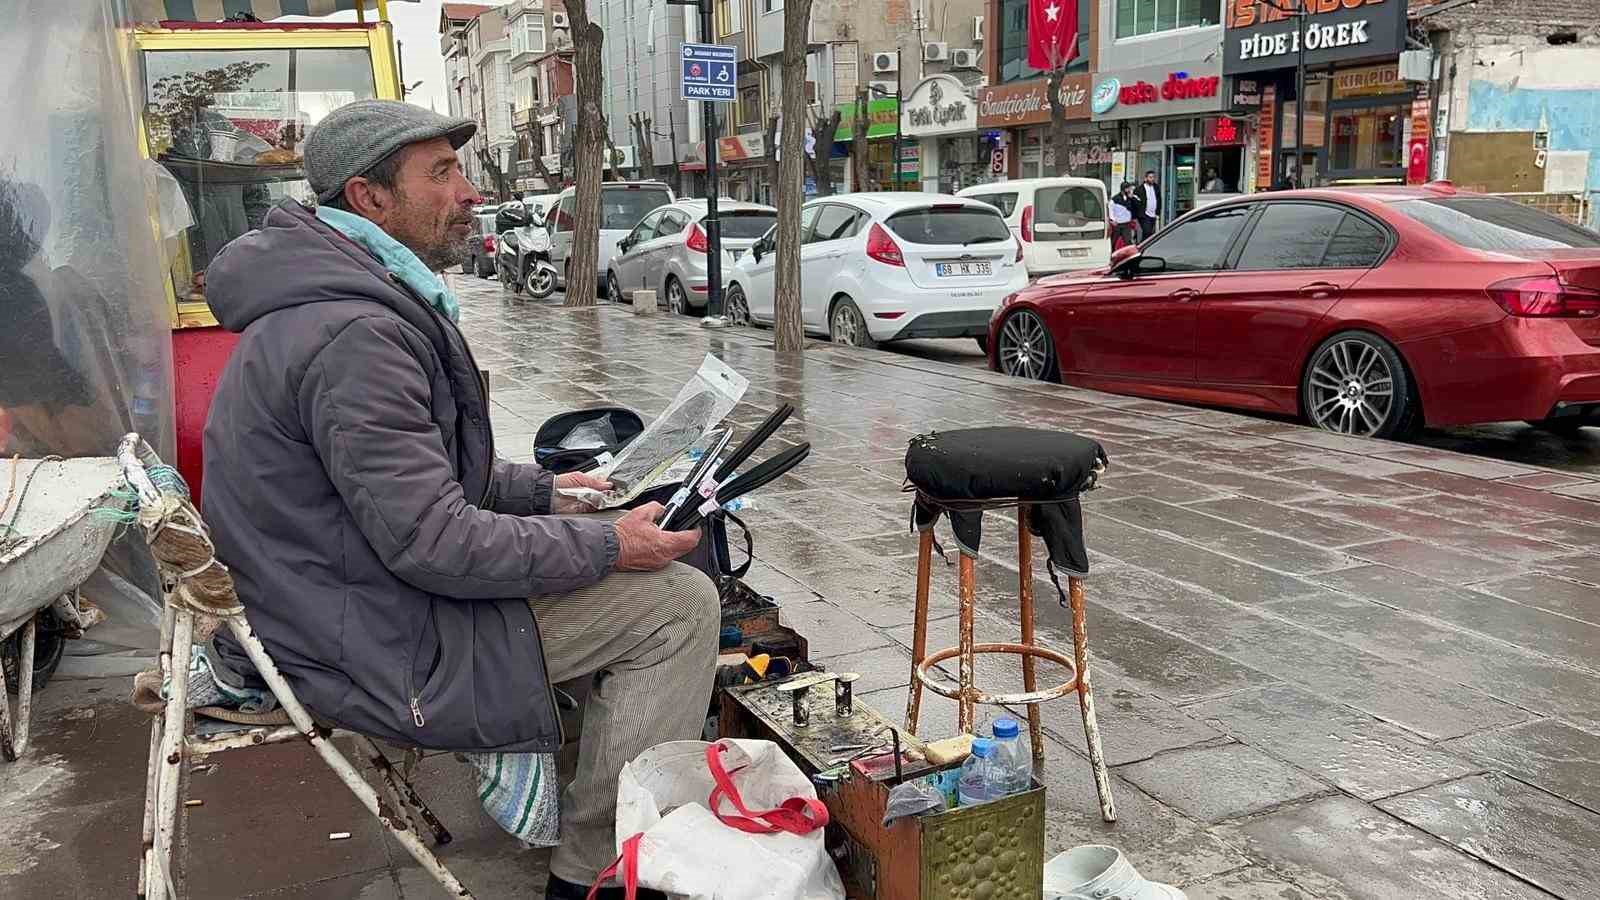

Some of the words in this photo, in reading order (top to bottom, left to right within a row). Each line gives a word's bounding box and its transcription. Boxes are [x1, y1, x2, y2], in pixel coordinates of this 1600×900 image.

[1239, 33, 1288, 60] PİDE
[687, 86, 710, 96] PARK
[1119, 80, 1158, 105] usta
